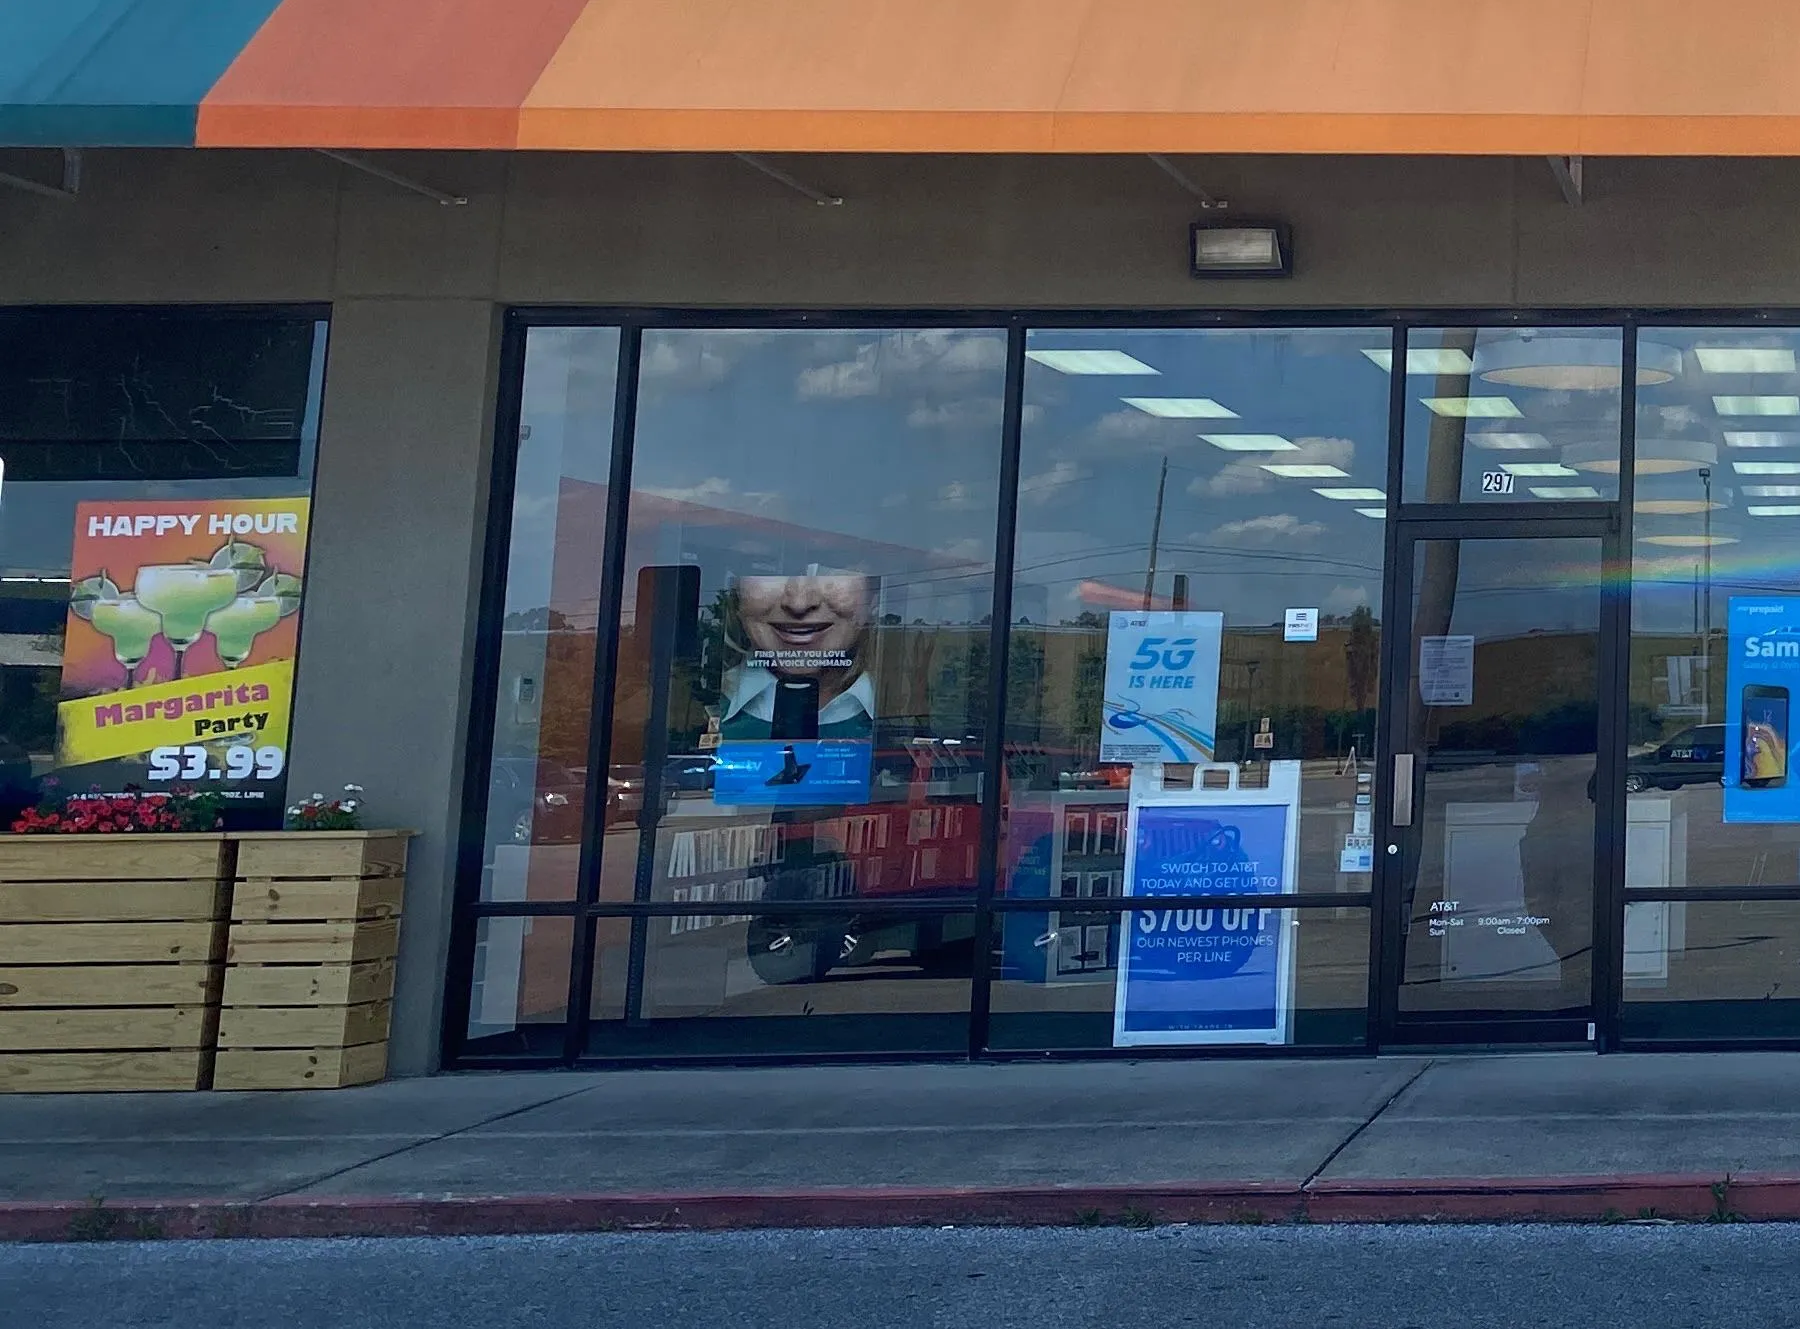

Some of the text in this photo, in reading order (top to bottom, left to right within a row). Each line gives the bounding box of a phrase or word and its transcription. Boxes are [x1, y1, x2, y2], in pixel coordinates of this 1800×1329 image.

[1483, 473, 1513, 492] 297
[88, 513, 297, 537] HAPPY HOUR
[1749, 605, 1784, 615] prepaid
[754, 650, 846, 658] FIND WHAT YOU LOVE
[1129, 638, 1198, 671] 5G
[746, 659, 853, 667] WITH A VOICE COMMAND
[1129, 675, 1195, 689] IS HERE
[94, 682, 270, 729] Margarita
[194, 711, 270, 736] Party
[147, 746, 285, 782] $3.99
[1161, 861, 1259, 874] SWITCH TO AT&T
[1141, 876, 1277, 889] TODAY AND GET UP TO
[1430, 901, 1459, 912] AT&T
[1429, 918, 1464, 926] Mon-Sat
[1429, 926, 1526, 936] Sun Closed
[1136, 935, 1274, 948] OUR NEWEST PHONES
[1177, 951, 1232, 962] PER LINE
